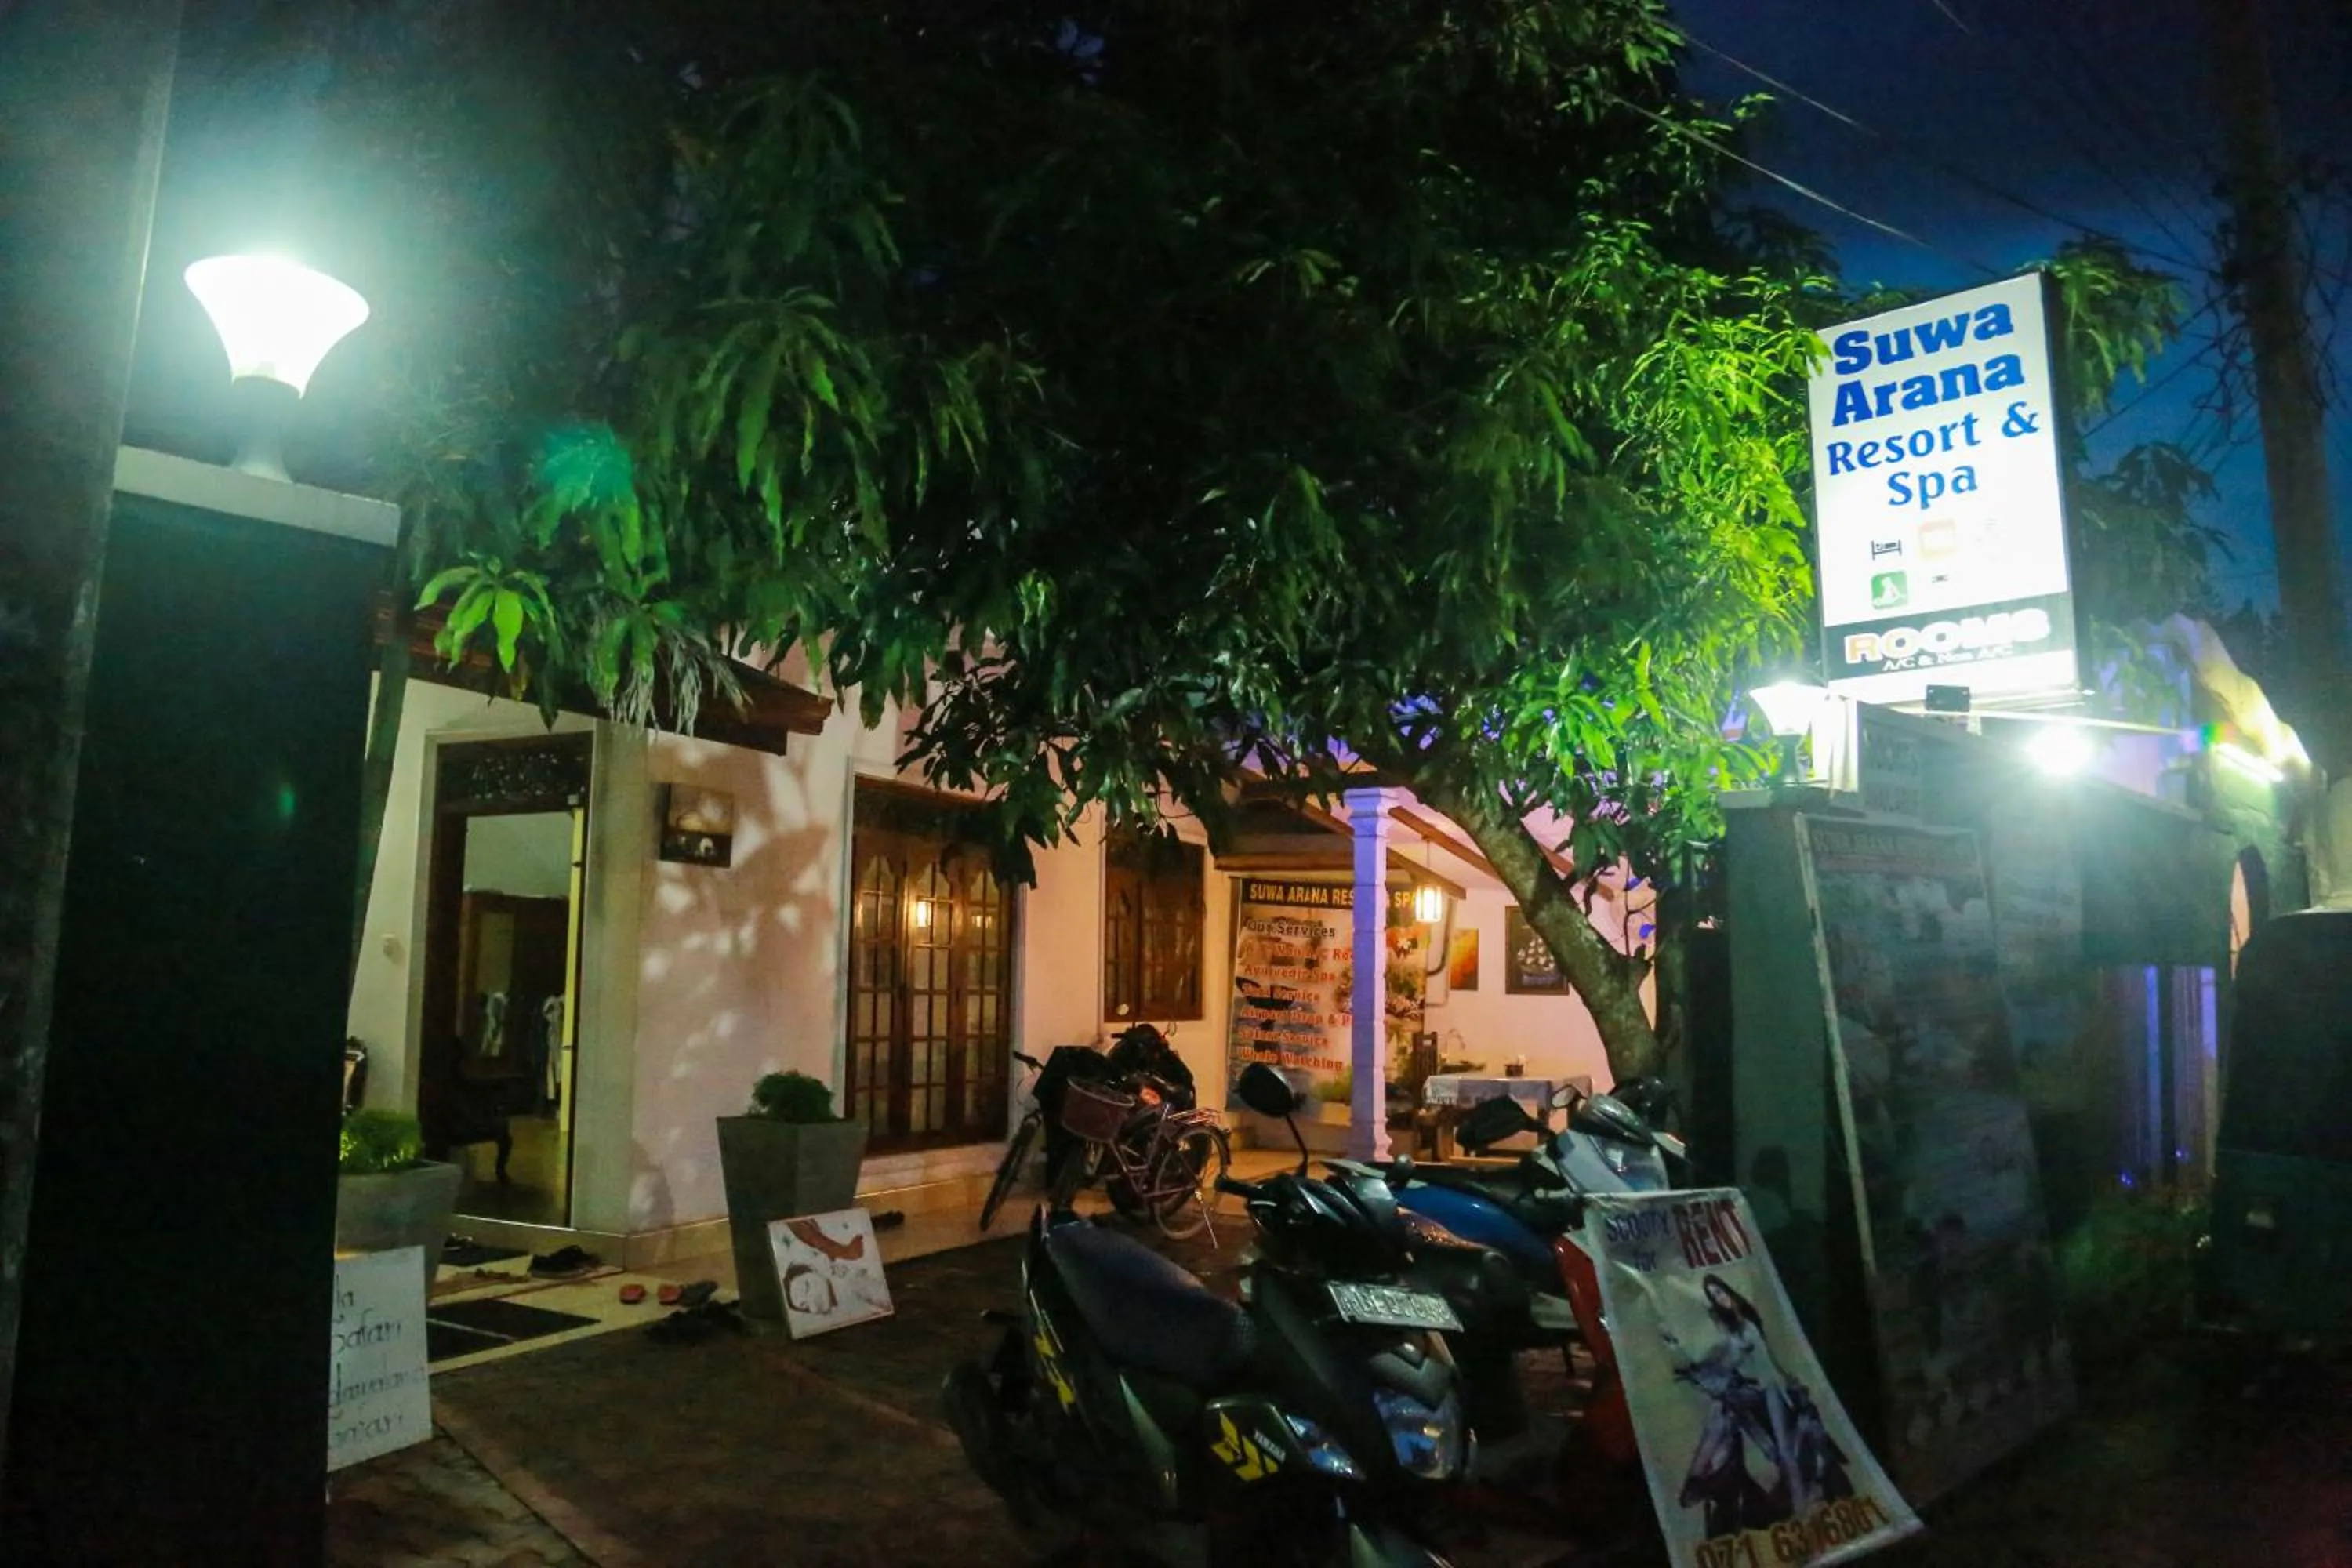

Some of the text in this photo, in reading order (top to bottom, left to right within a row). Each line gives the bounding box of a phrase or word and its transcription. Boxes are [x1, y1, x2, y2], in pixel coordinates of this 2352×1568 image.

[1833, 303, 2014, 376] Suwa
[1832, 353, 2025, 427] Arana
[1827, 401, 2040, 476] Resort &
[1888, 465, 1978, 510] Spa
[1844, 608, 2051, 664] ROOMS
[1250, 884, 1283, 902] SUWA
[1287, 886, 1328, 905] ARANA
[1277, 921, 1335, 938] Services
